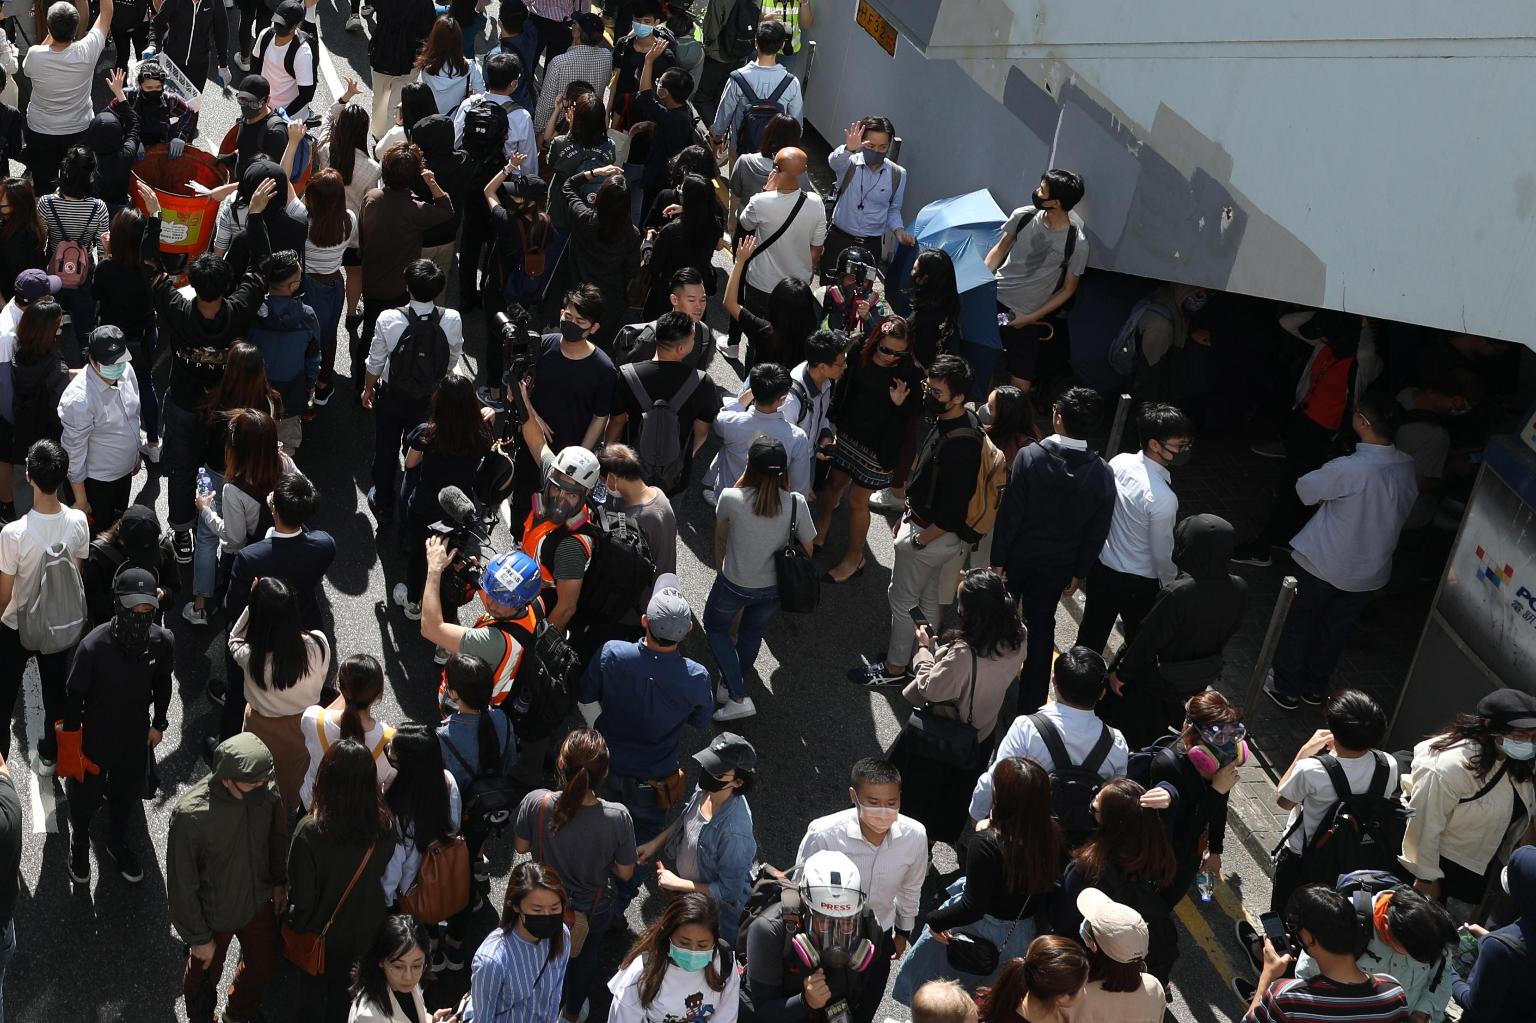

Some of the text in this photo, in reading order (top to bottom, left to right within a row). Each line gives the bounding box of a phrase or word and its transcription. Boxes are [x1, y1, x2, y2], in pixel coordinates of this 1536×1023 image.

[860, 7, 887, 40] HF32
[502, 565, 521, 583] PRESS
[820, 901, 852, 912] PRESS
